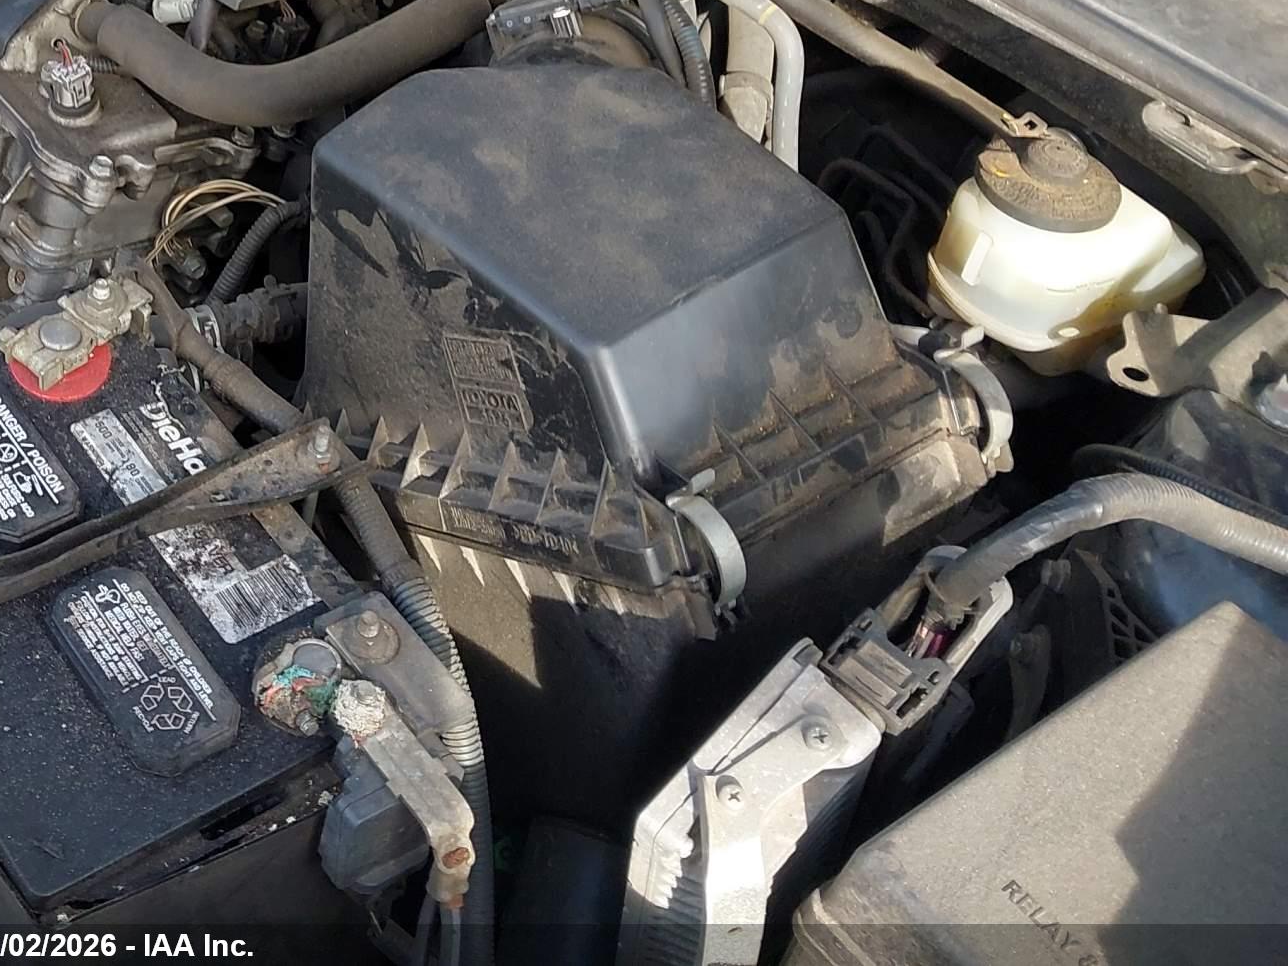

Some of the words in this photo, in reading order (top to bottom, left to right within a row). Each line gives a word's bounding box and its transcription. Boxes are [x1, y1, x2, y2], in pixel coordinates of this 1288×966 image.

[137, 398, 212, 477] DieHa
[25, 447, 65, 494] POISON
[124, 461, 141, 477] 80
[0, 473, 25, 504] SULFURIC
[18, 501, 36, 518] ACID
[94, 617, 107, 629] FOR
[103, 609, 125, 633] MEDICAL
[119, 631, 135, 648] HELP
[119, 601, 137, 620] FLUSH
[131, 619, 147, 635] EYES
[119, 582, 130, 593] DO
[125, 591, 139, 604] NOT
[142, 614, 157, 630] KEEP
[153, 630, 168, 646] VENT
[164, 645, 179, 661] CAPS
[176, 660, 192, 678] TIGHT
[188, 677, 202, 692] AND
[133, 589, 148, 605] KEEP
[143, 604, 157, 618] OUT
[152, 616, 164, 627] OF
[159, 626, 172, 638] THE
[167, 637, 186, 657] REACH
[87, 620, 116, 656] INSTRUCTIONS
[115, 660, 135, 682] VEHICLE
[98, 649, 112, 662] NOT
[135, 639, 149, 652] GET
[130, 705, 155, 733] RECYCLE
[1001, 879, 1081, 950] RELAY
